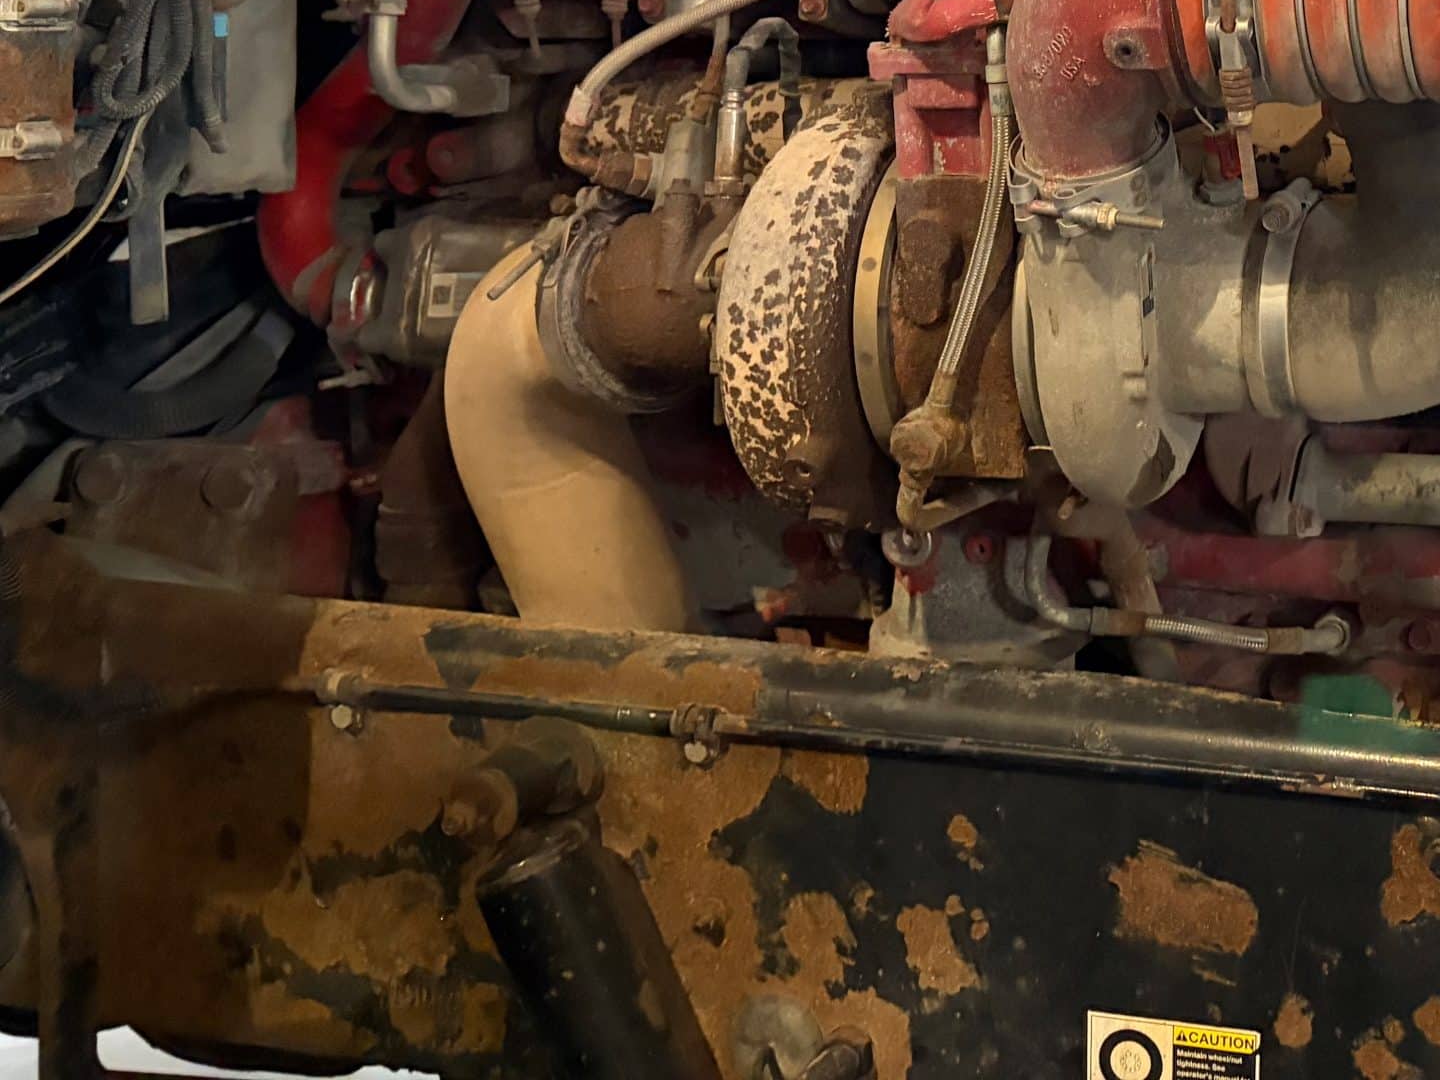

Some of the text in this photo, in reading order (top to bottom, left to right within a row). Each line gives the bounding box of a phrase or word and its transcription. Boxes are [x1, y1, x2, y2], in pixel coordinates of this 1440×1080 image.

[1059, 53, 1086, 81] USA
[1188, 1032, 1254, 1049] CAUTION
[1176, 1048, 1207, 1059] Maintain
